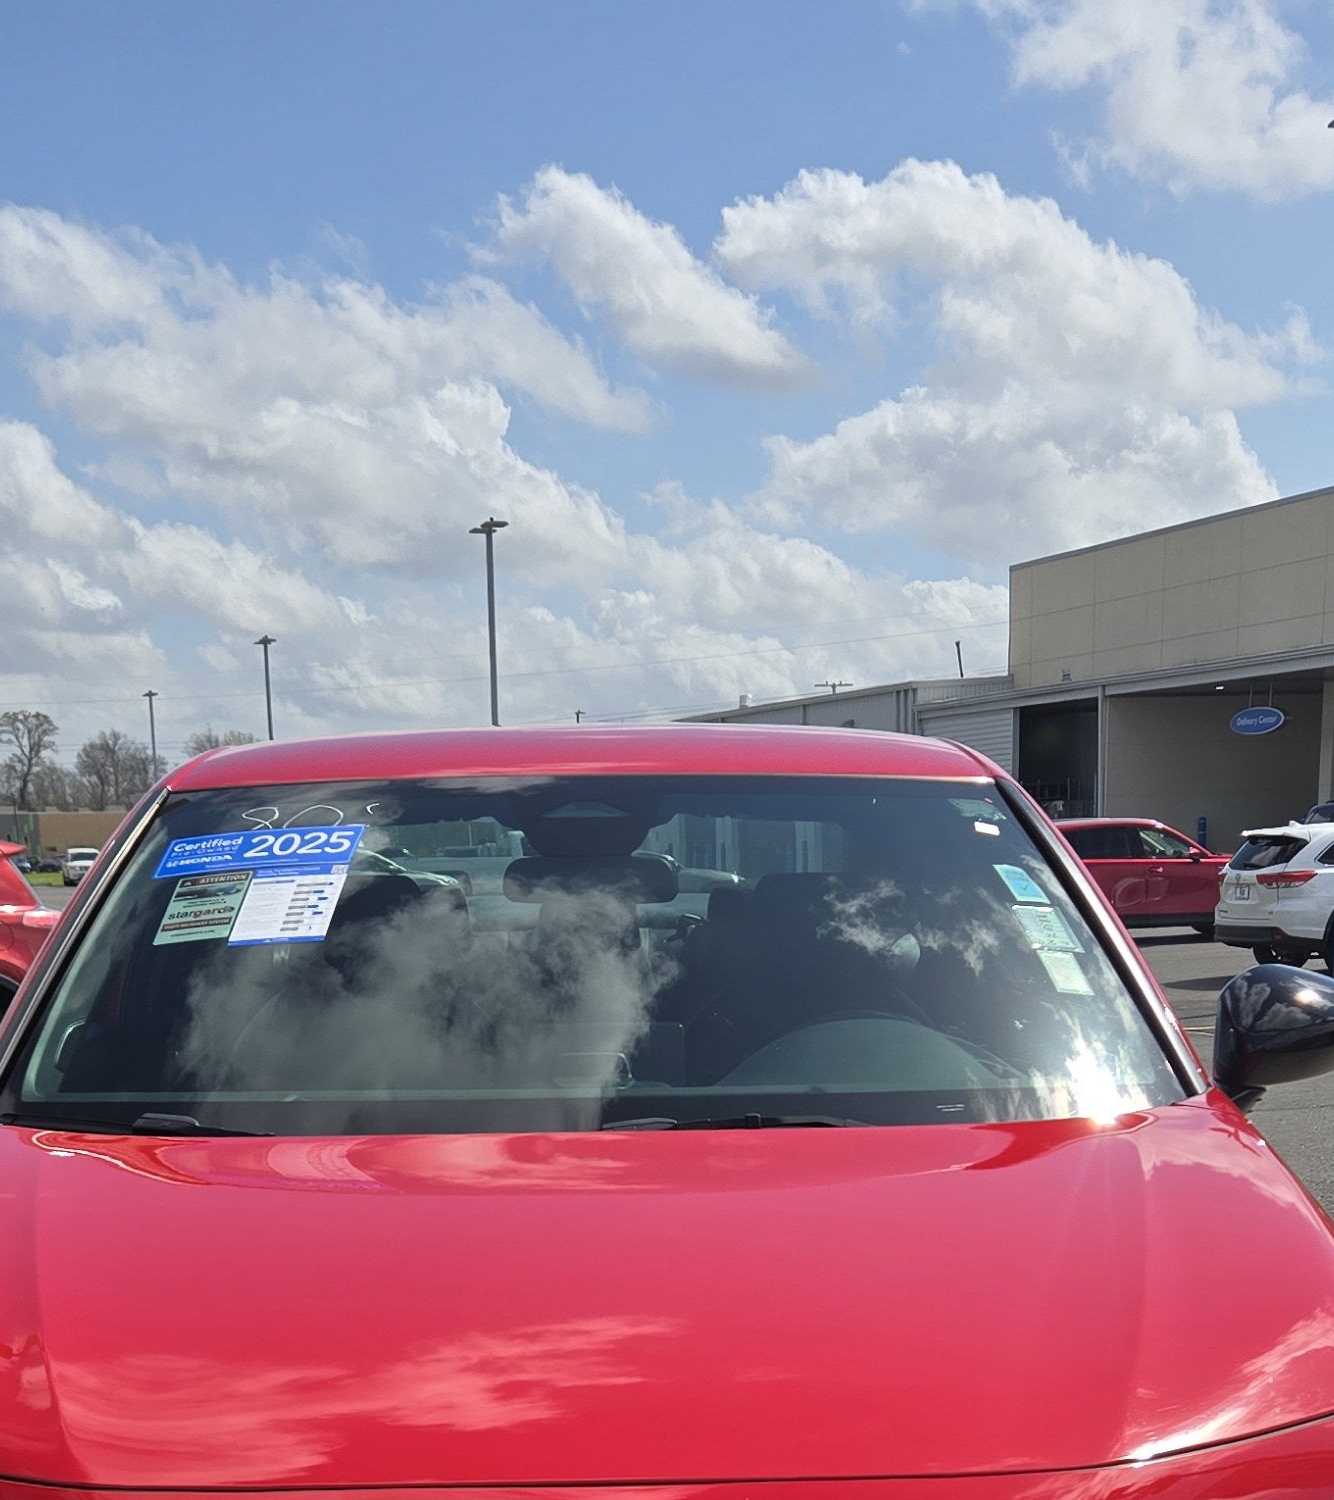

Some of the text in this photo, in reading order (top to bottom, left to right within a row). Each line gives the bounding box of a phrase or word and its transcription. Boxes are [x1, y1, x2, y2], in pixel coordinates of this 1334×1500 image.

[174, 836, 243, 852] Certified
[243, 831, 355, 858] 2025
[178, 854, 233, 866] HONDA
[199, 874, 247, 884] ATTENTION
